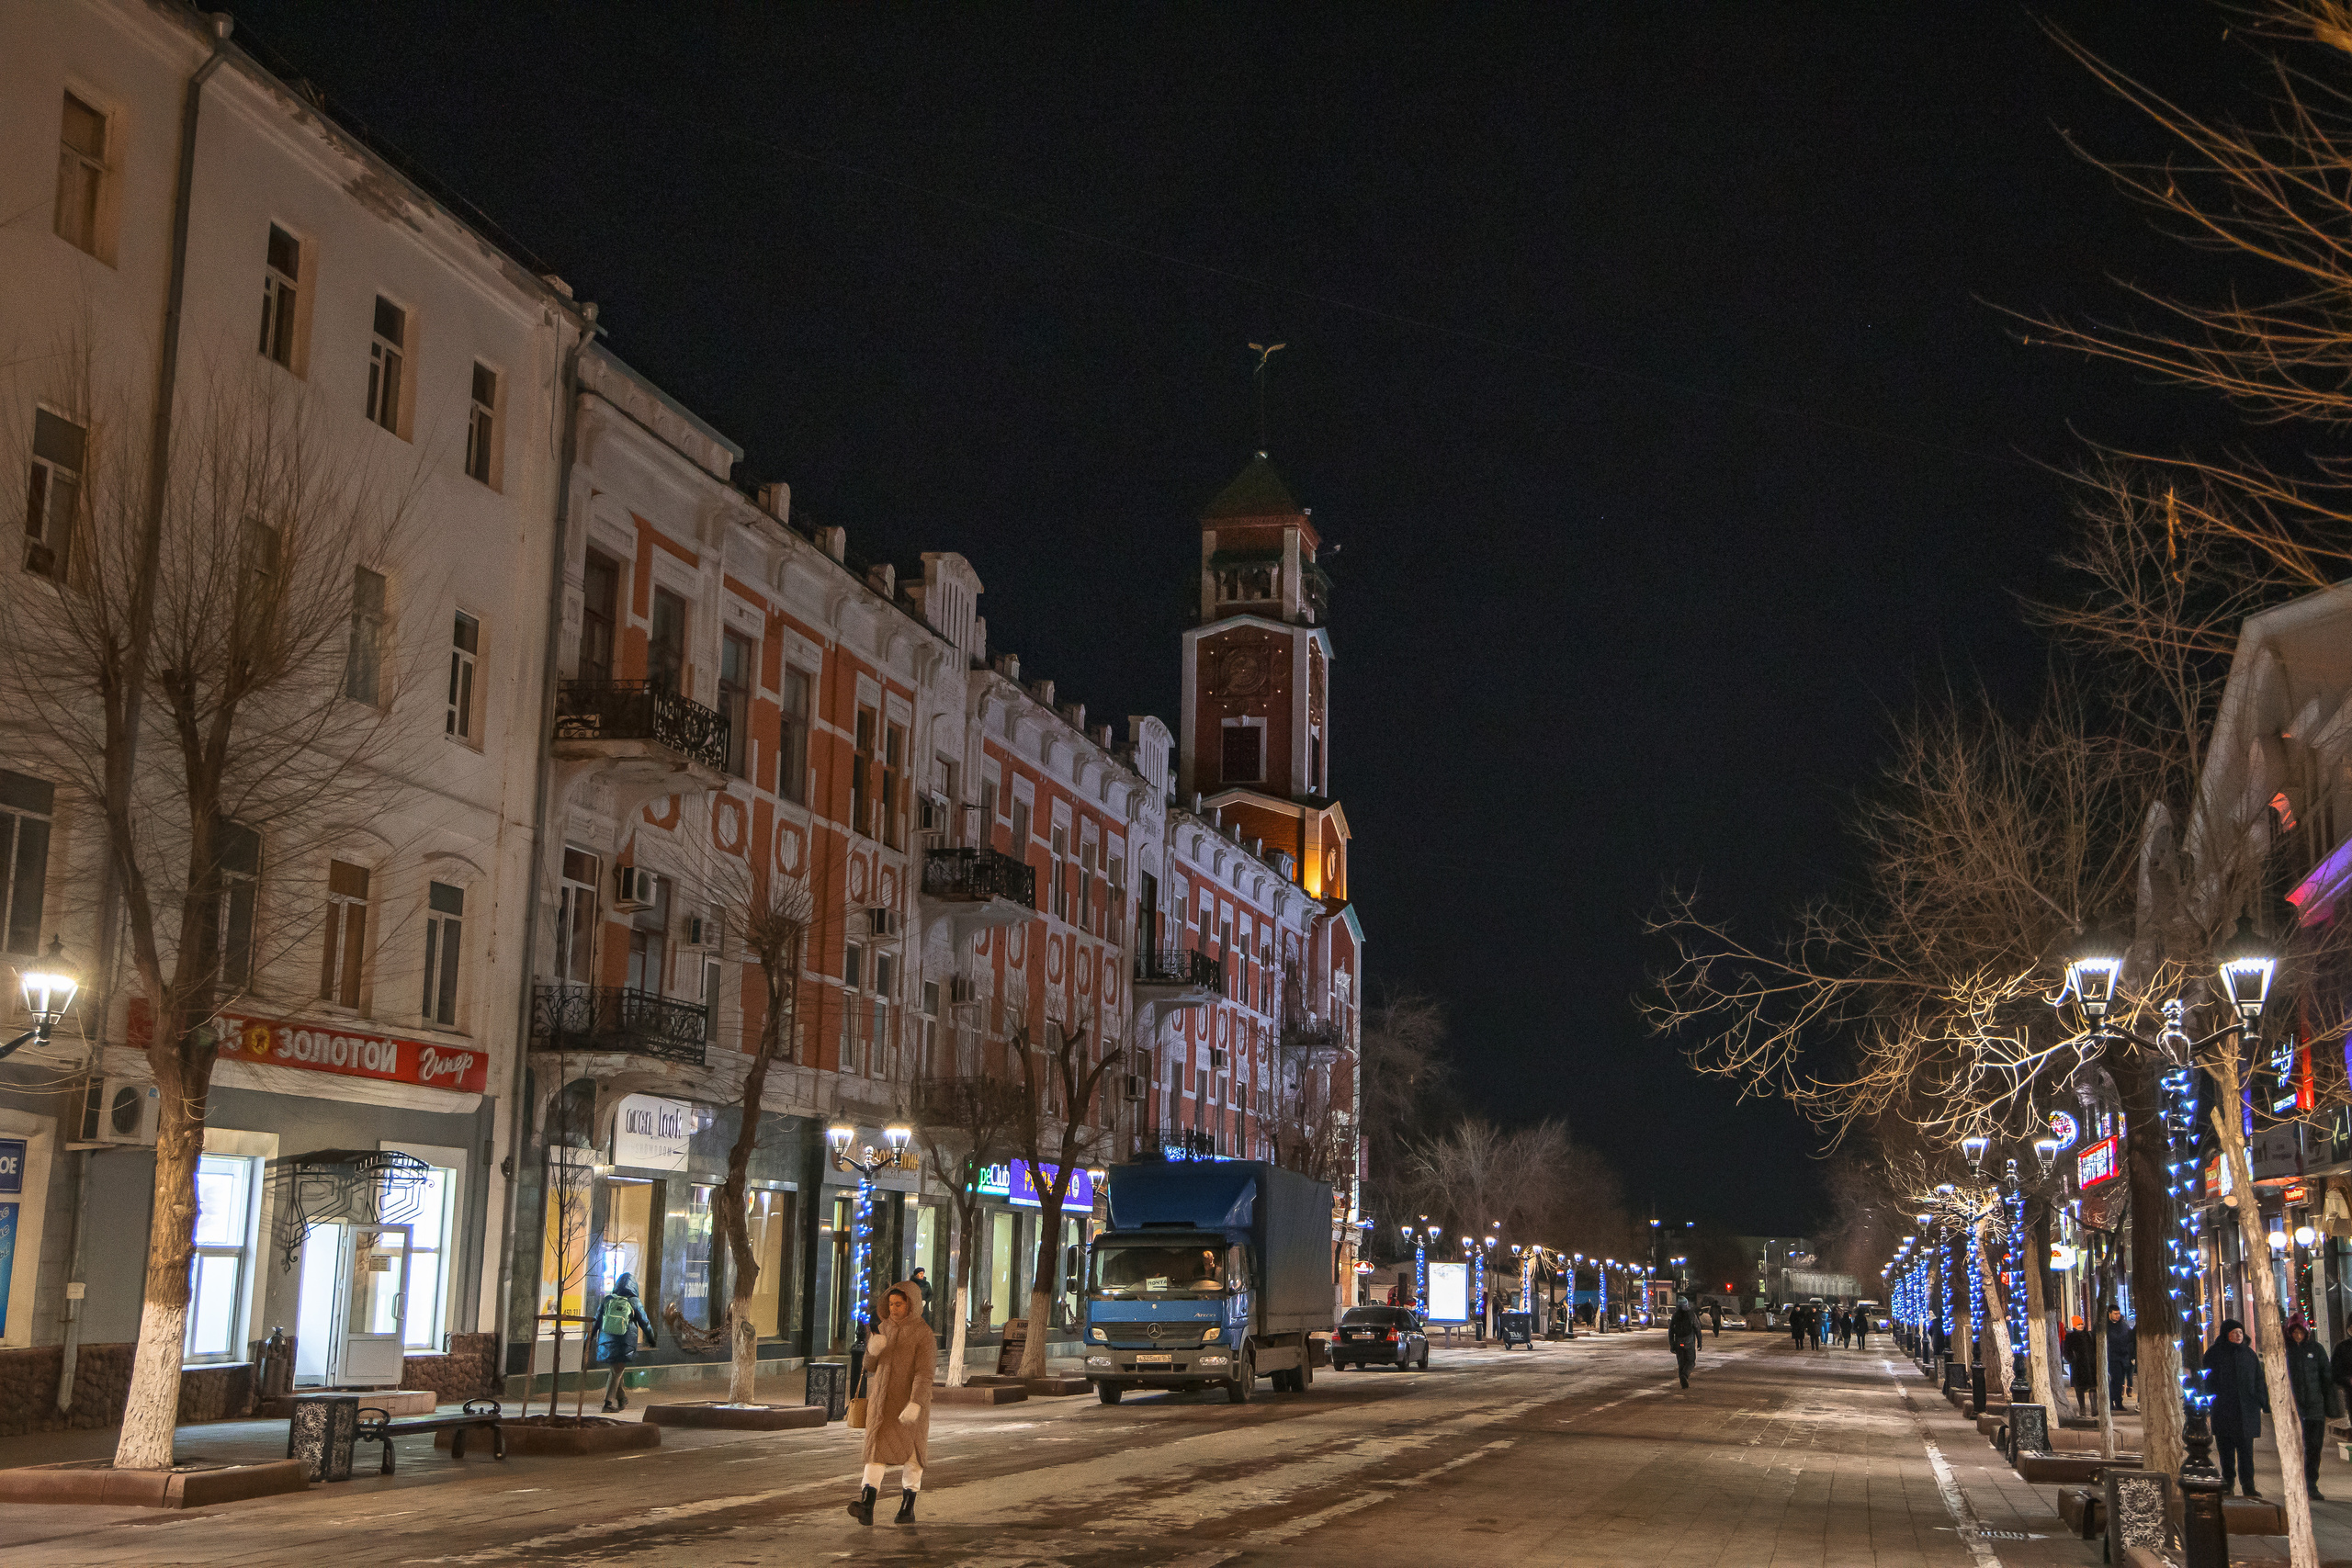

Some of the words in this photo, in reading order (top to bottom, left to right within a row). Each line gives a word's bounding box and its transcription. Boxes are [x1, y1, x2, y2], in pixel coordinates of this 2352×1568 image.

[277, 1027, 398, 1074] ЗОЛОТОЙ
[419, 1047, 474, 1084] Гипер
[627, 1108, 652, 1135] oren
[659, 1106, 683, 1139] look
